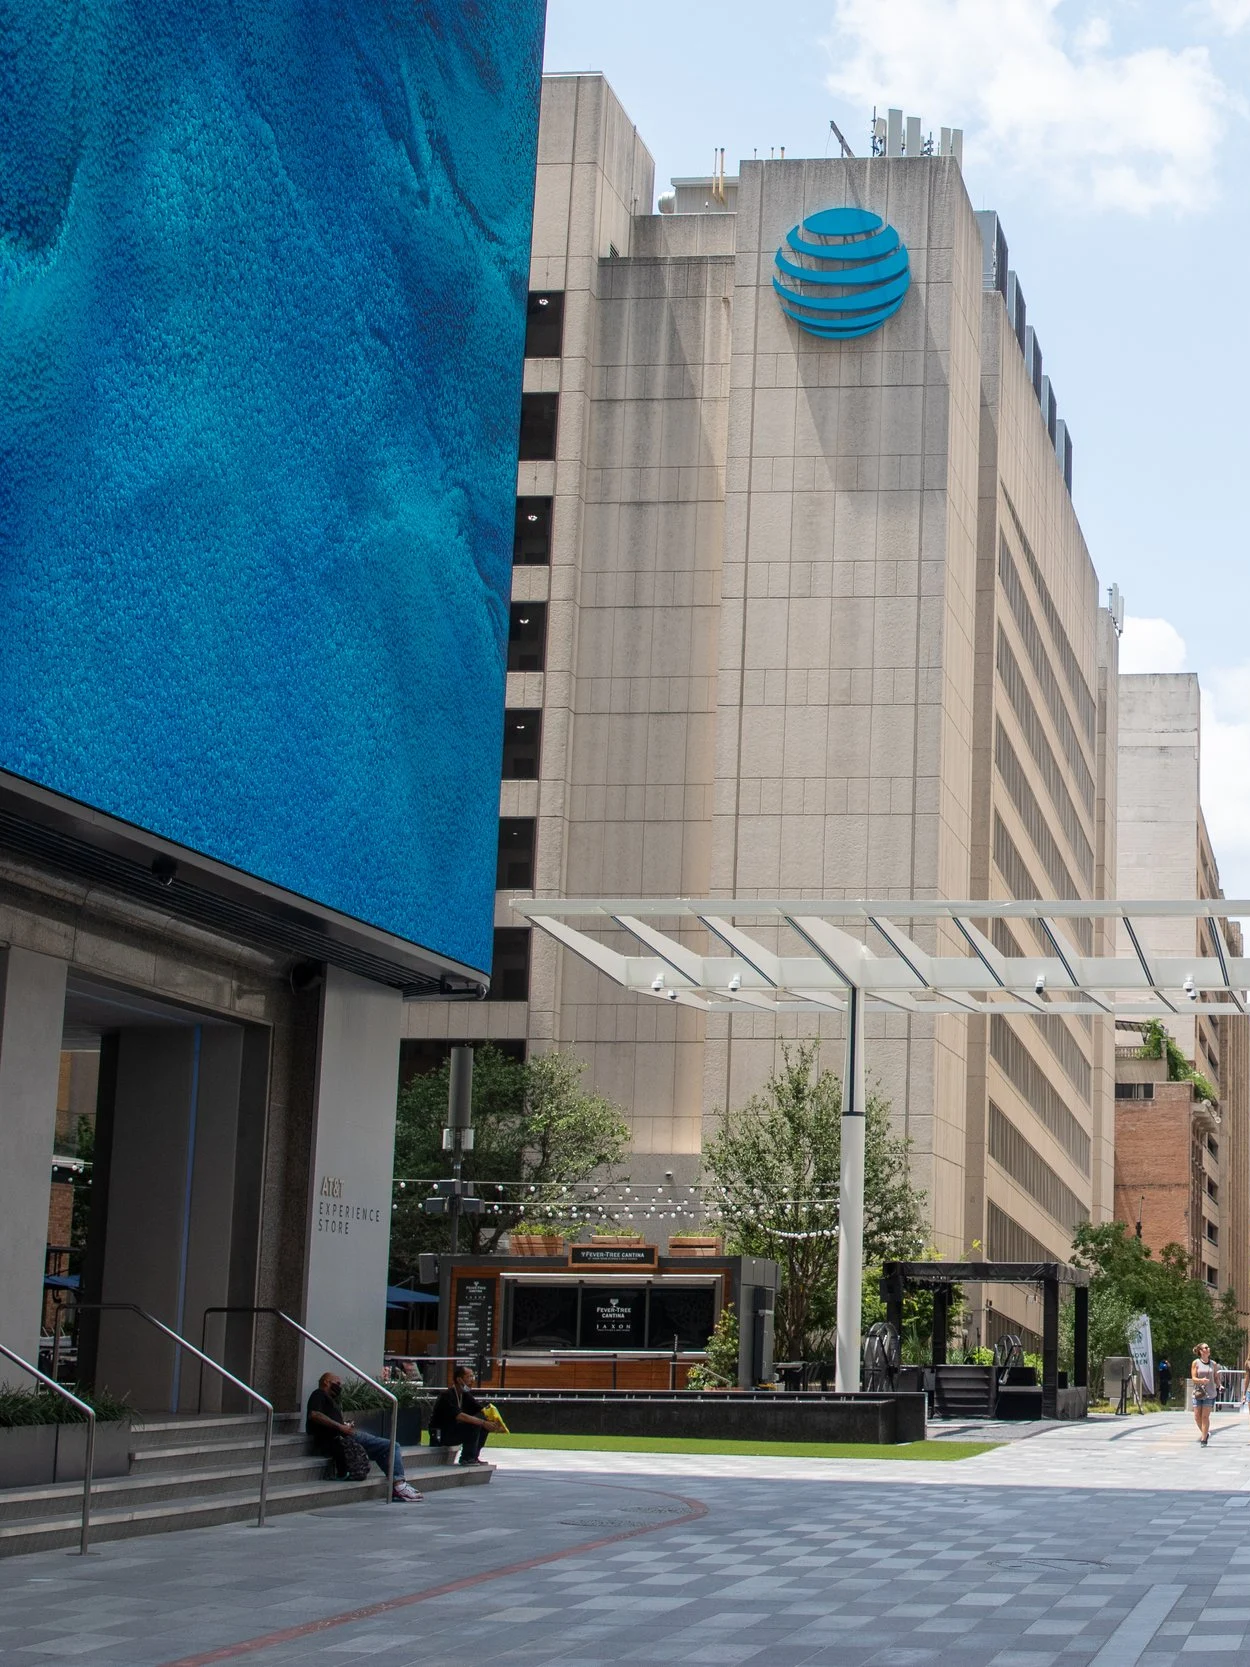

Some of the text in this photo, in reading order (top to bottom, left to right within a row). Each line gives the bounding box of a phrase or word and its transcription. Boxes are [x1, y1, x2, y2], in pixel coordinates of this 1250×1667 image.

[320, 1176, 344, 1198] AT&T
[319, 1201, 380, 1222] EXPERIENCE
[318, 1219, 349, 1235] STORE
[621, 1251, 645, 1259] CANTINA
